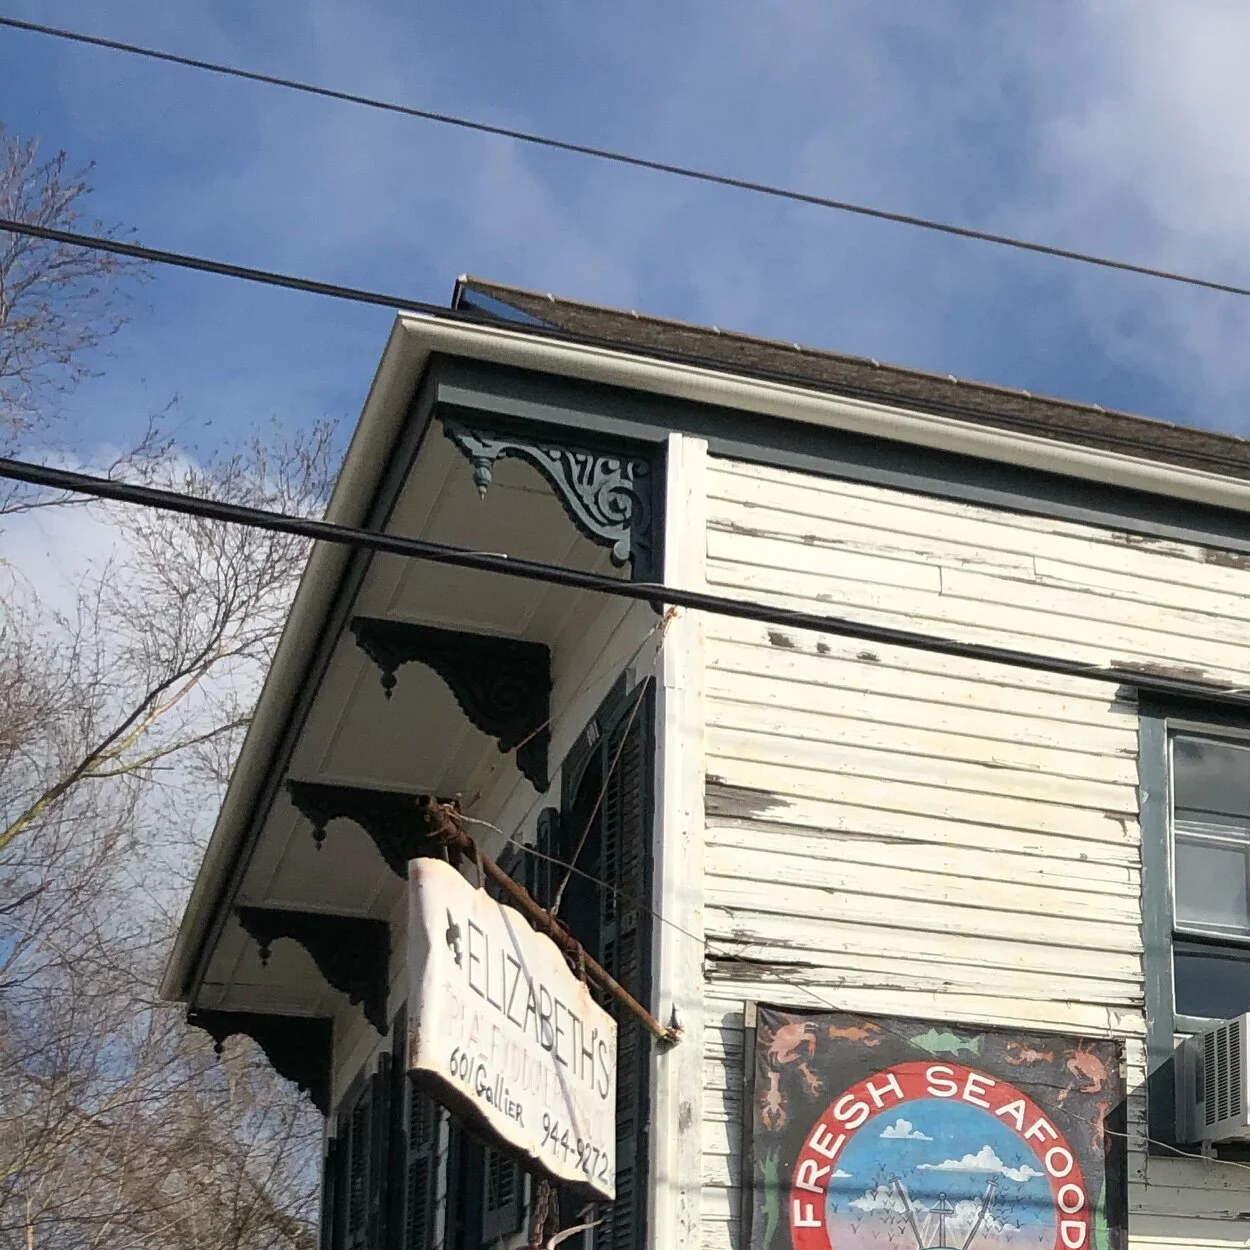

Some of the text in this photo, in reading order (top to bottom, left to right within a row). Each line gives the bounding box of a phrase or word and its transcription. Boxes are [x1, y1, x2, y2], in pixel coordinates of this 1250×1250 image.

[450, 1047, 474, 1082] 601
[467, 918, 609, 1101] ELIZABETH'S
[793, 1065, 1088, 1250] FRESH SEAFOOD
